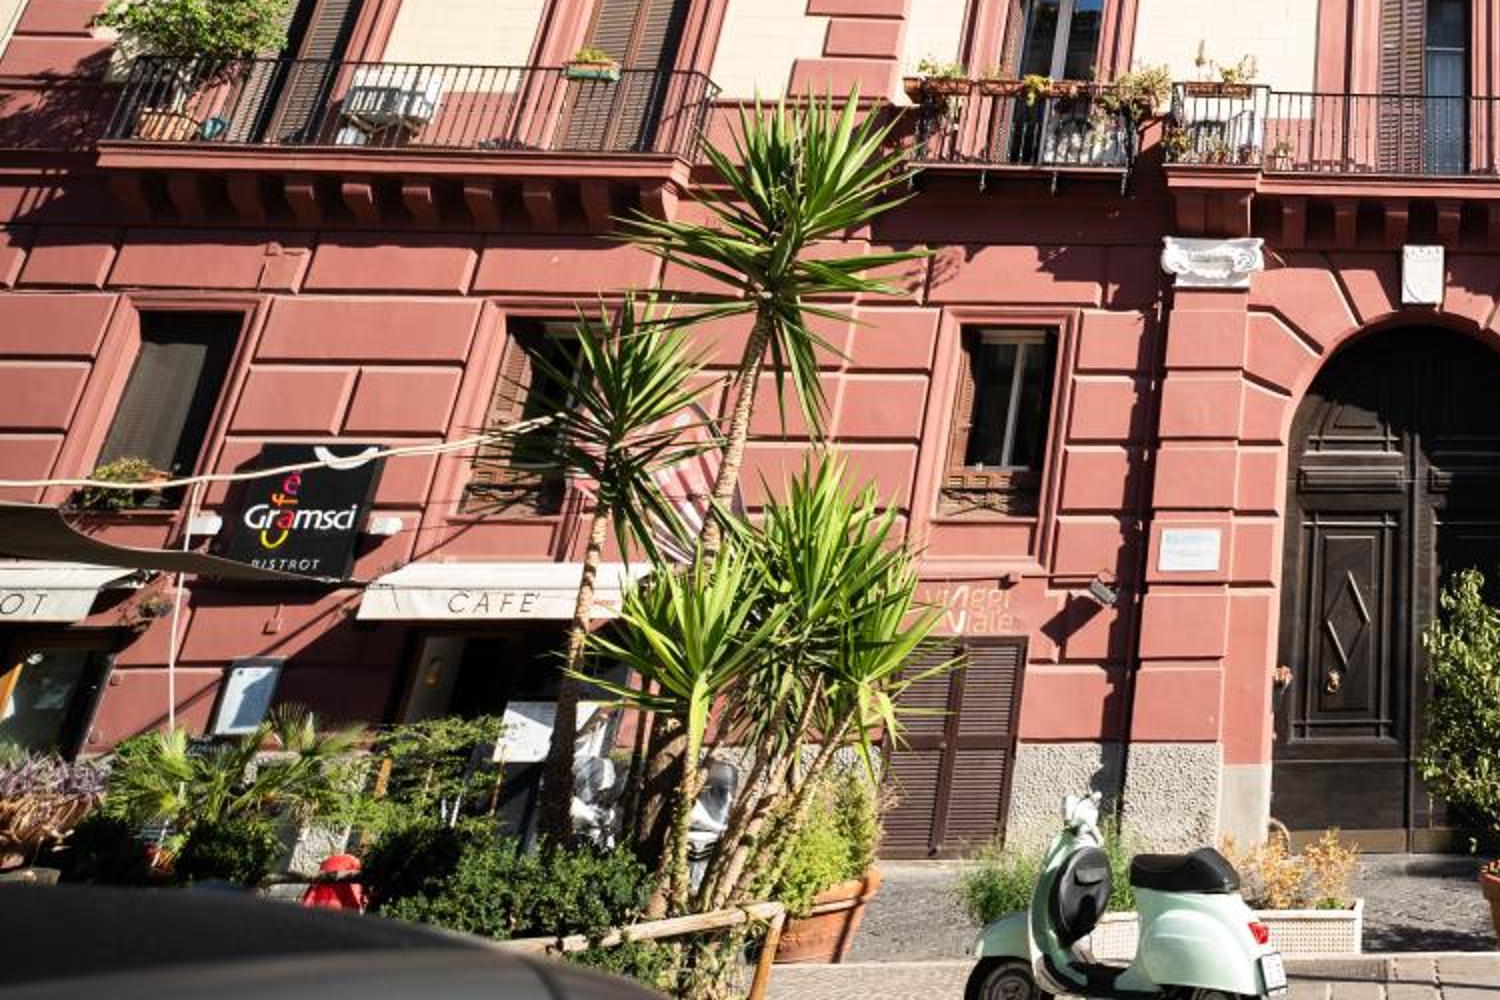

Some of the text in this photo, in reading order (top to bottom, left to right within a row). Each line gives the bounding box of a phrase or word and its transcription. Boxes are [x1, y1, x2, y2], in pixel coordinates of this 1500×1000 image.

[244, 503, 358, 530] Gramsci
[251, 558, 321, 572] BISTROT
[0, 592, 49, 616] OT
